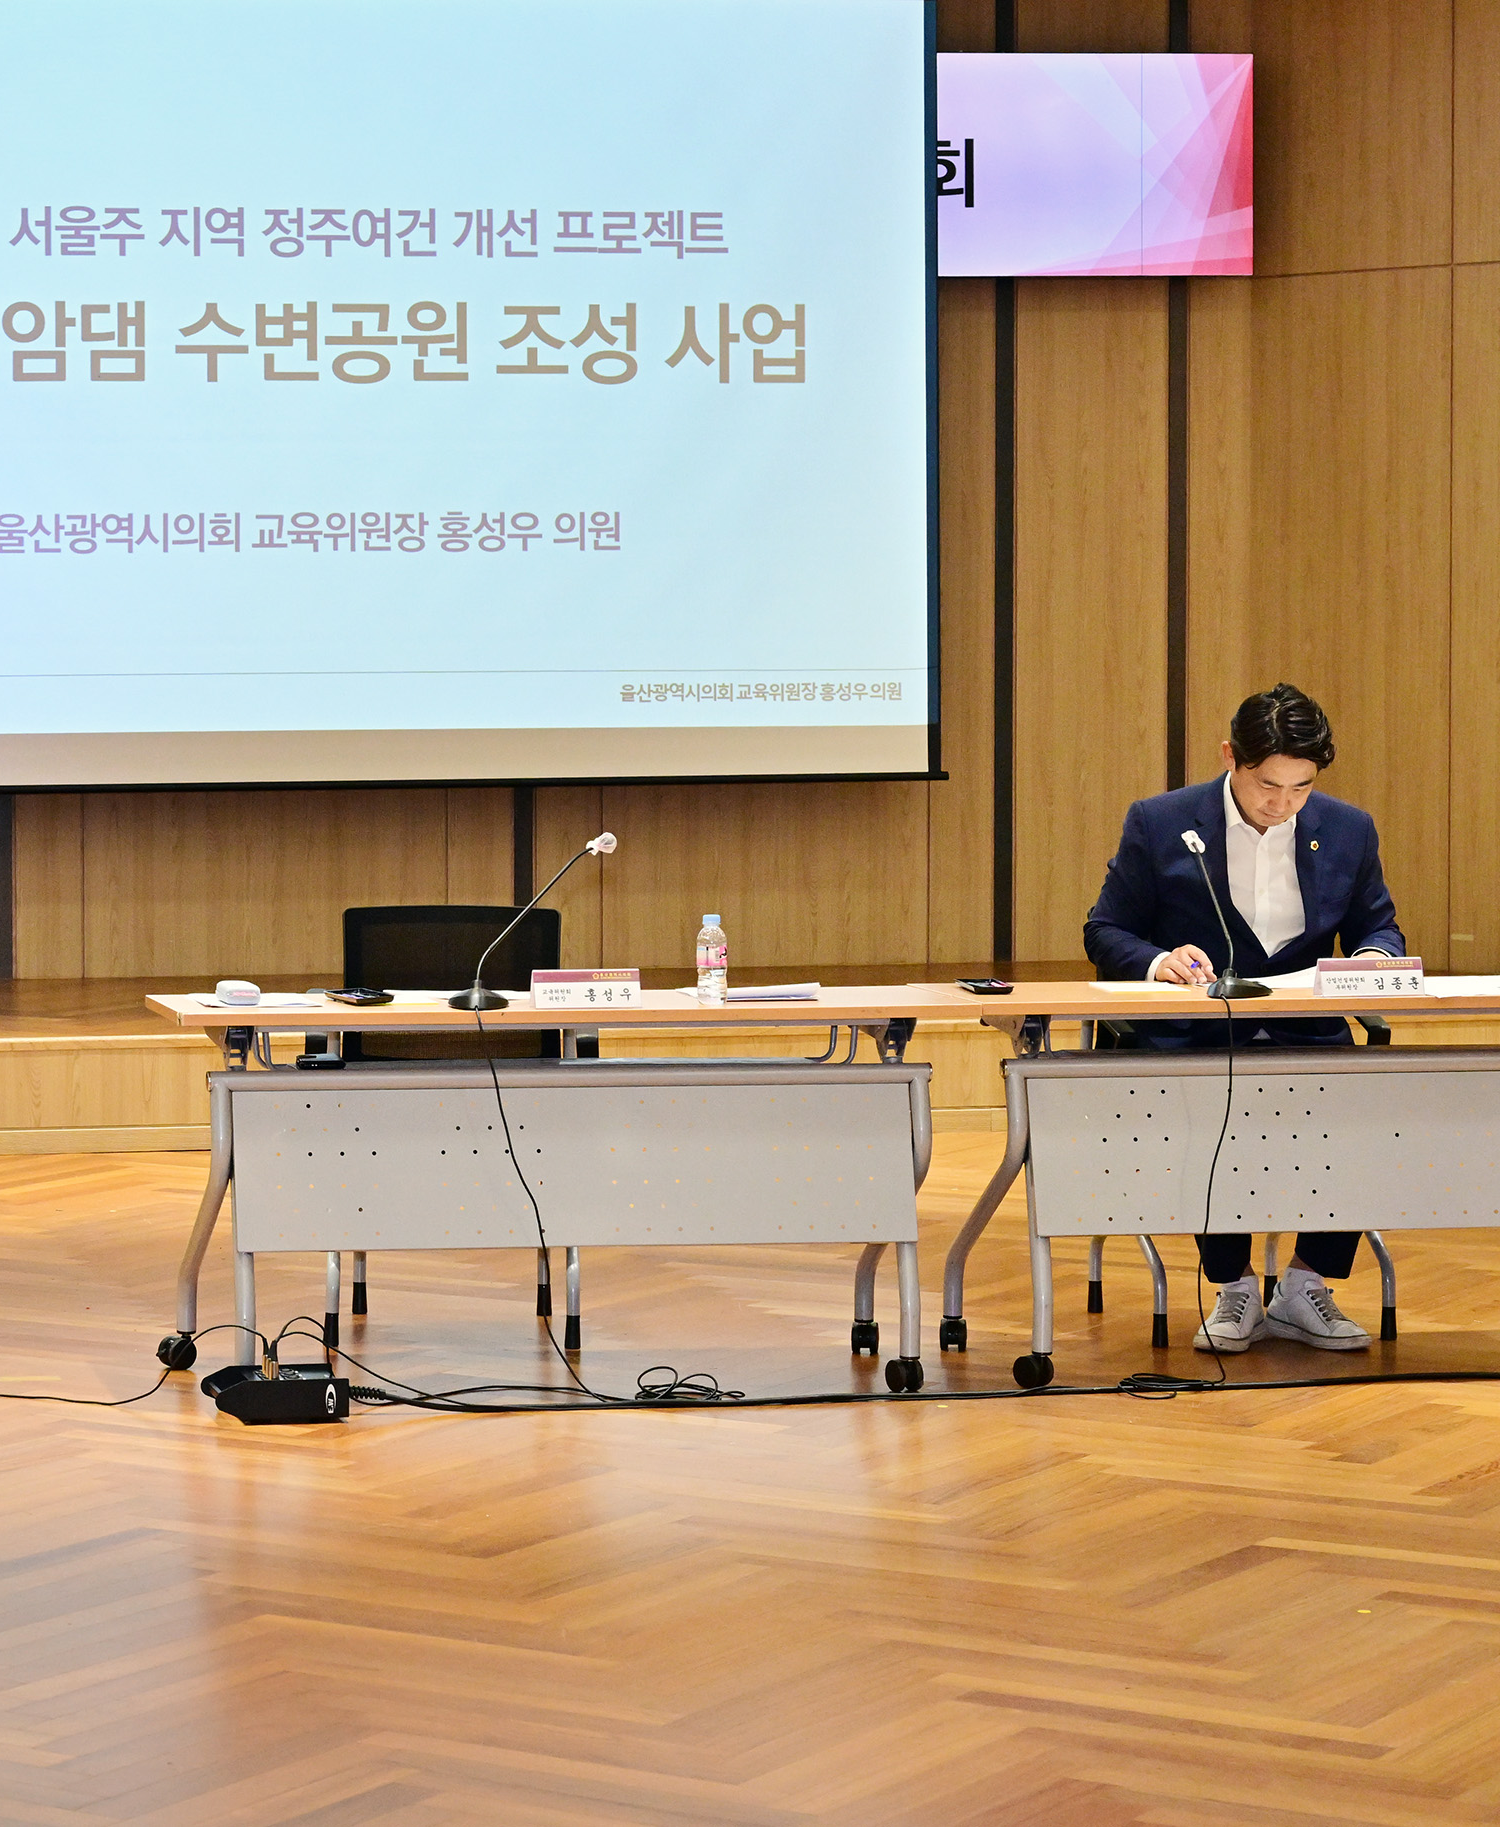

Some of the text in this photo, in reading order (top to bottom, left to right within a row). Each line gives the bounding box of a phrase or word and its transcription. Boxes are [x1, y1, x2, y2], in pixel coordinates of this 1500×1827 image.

[8, 205, 730, 261] 서울주 지역 정주여건 개선 프로젝트
[174, 300, 470, 386] 수변공원
[495, 301, 640, 387] 조성
[663, 301, 807, 386] 사업
[251, 511, 430, 554] 교육위원장
[437, 511, 544, 554] 홍성우
[553, 510, 622, 552] 의원
[619, 681, 903, 703] 울산광역시의회 교육위원장 홍성우 의원
[584, 987, 632, 1003] 홍성우
